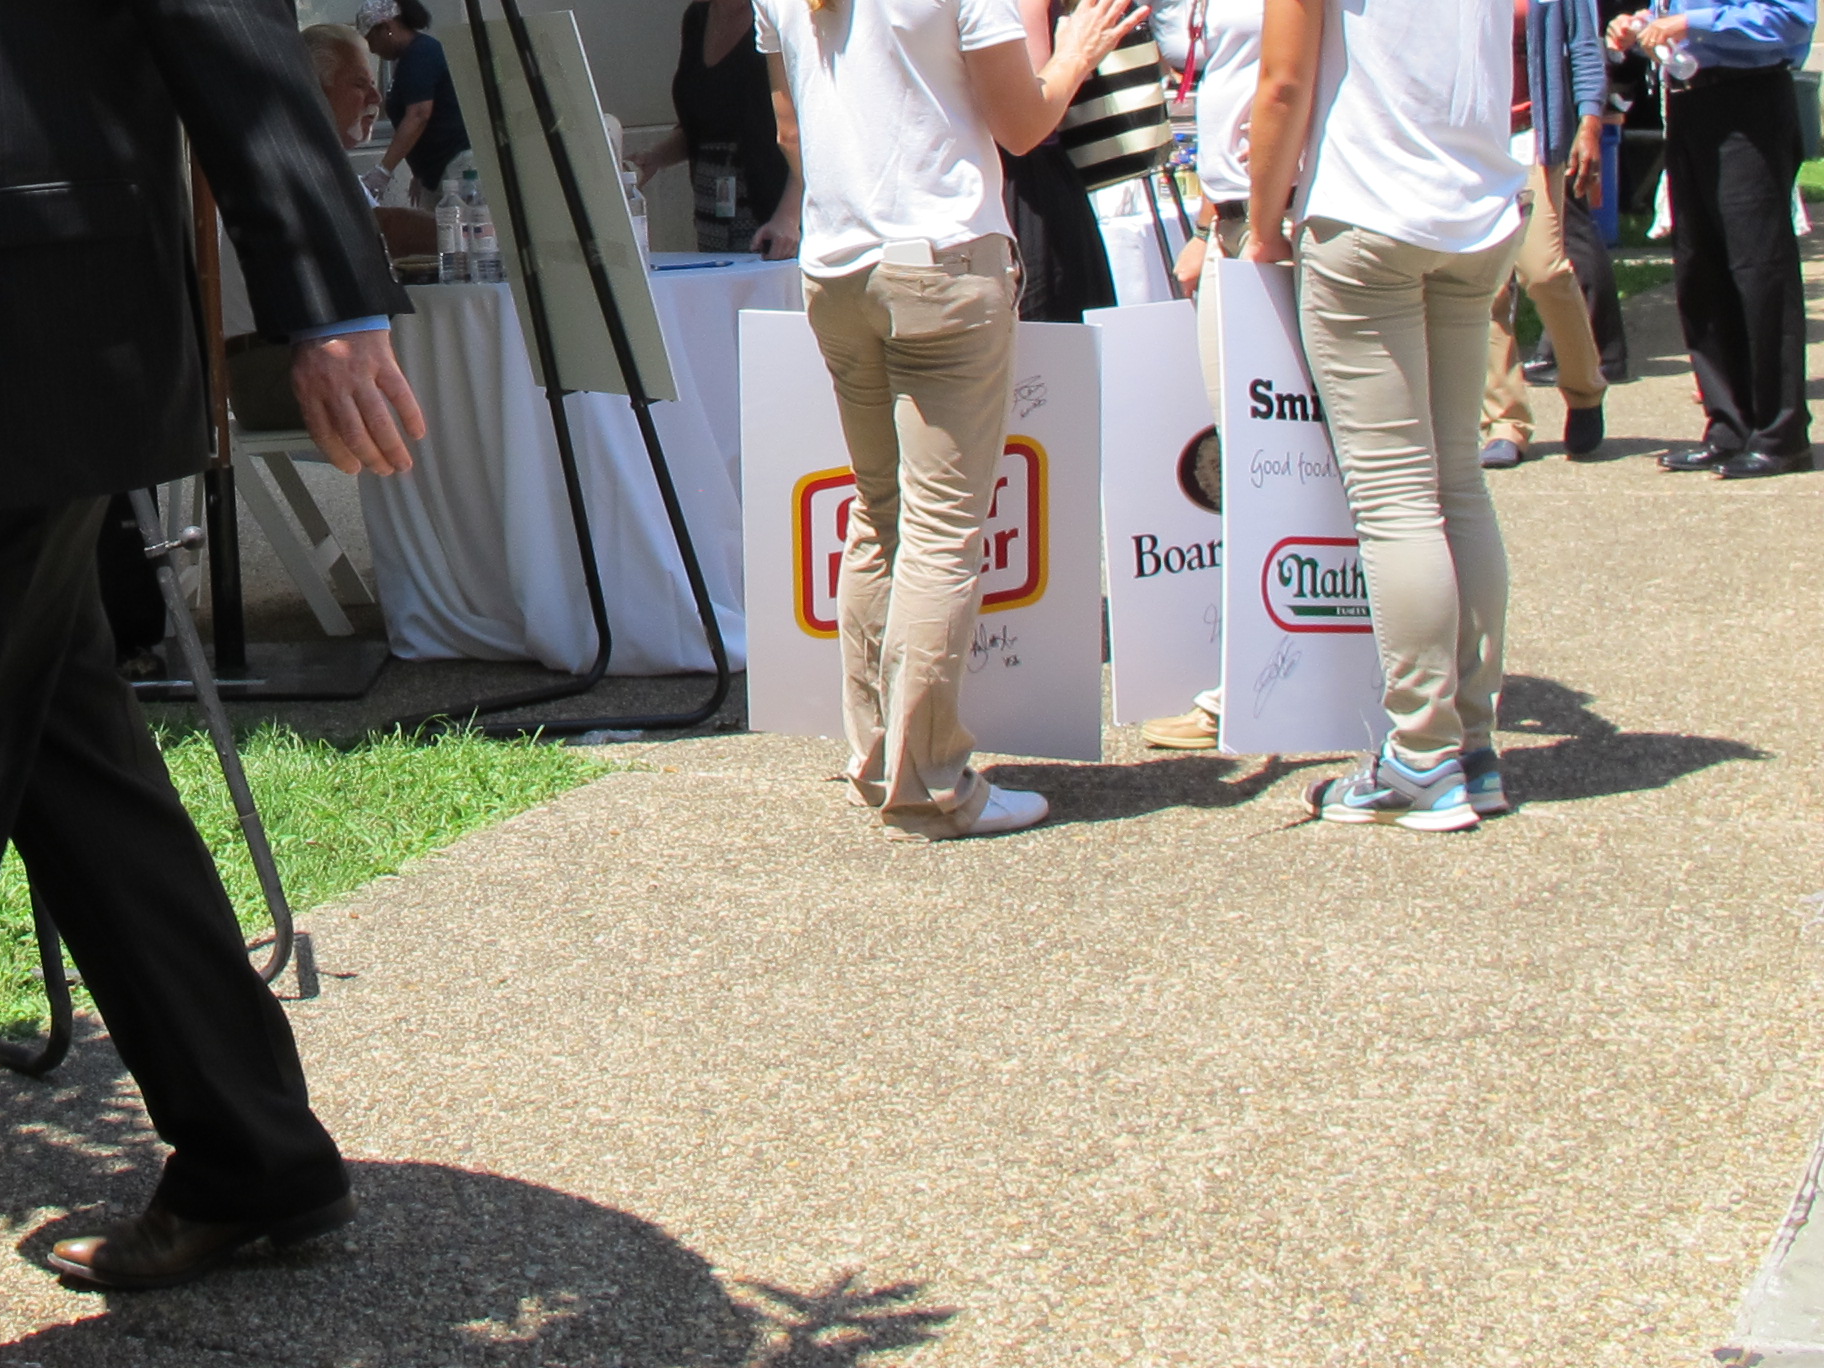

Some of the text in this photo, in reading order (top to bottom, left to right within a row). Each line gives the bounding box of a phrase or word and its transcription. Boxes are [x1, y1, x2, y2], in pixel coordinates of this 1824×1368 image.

[1249, 378, 1324, 422] Smi
[1250, 449, 1292, 489] Good
[1131, 533, 1222, 579] Boar
[1277, 553, 1368, 599] Nath
